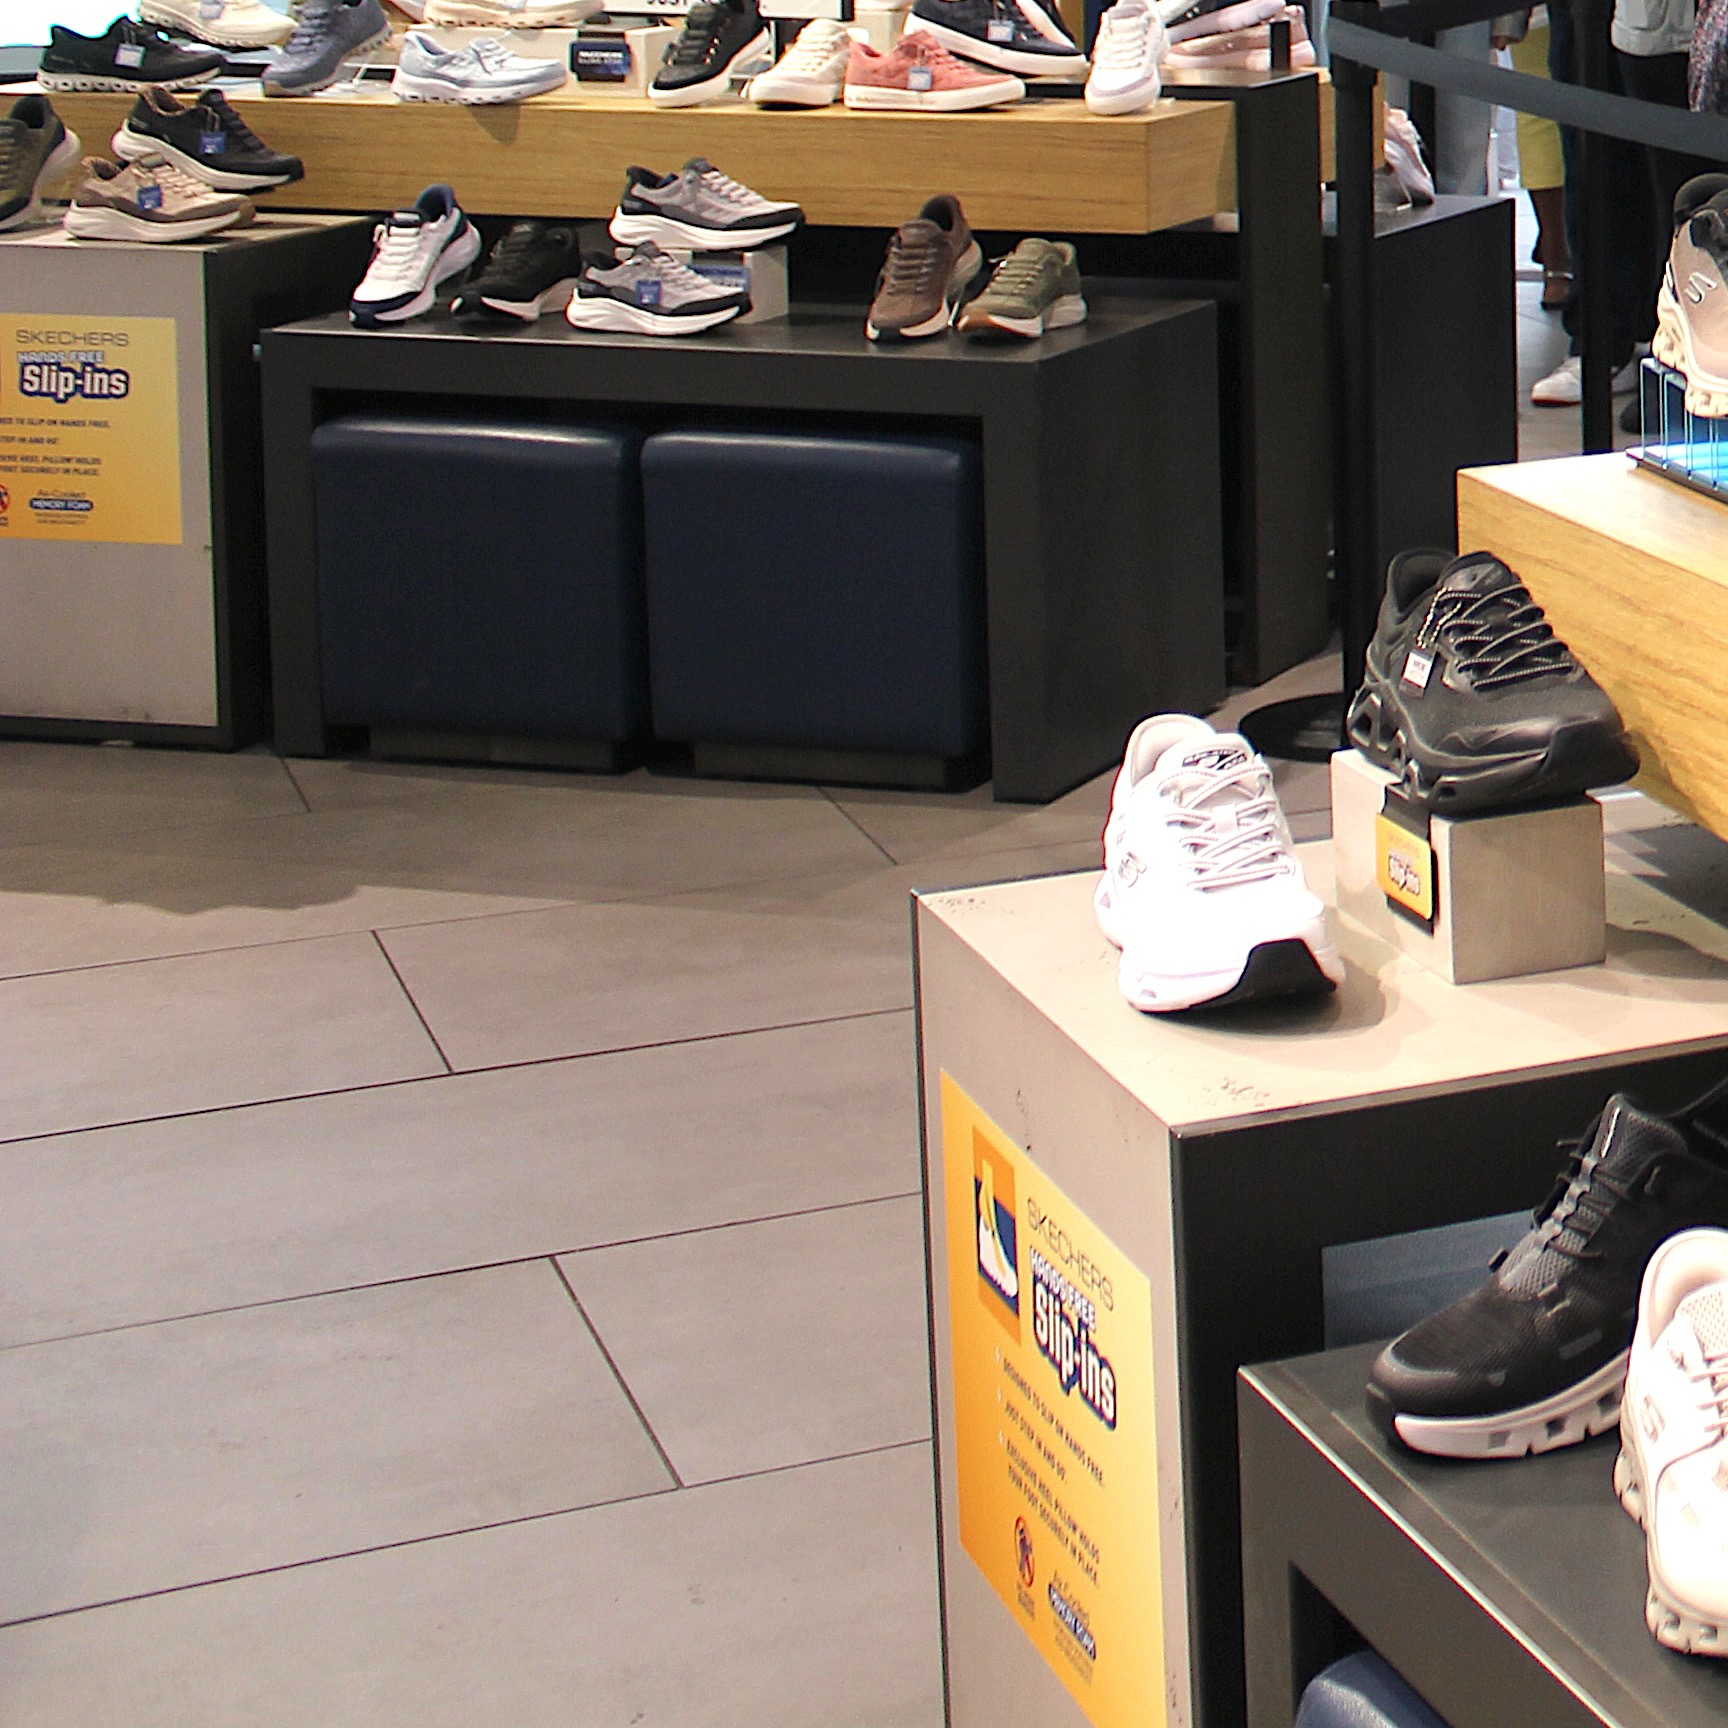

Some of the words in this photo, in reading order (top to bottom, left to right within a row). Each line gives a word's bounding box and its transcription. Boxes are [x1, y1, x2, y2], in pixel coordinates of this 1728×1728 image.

[16, 329, 129, 347] SKECHERS
[21, 363, 130, 401] Slip-ins
[1027, 1197, 1114, 1312] SKECHERS
[1034, 1278, 1116, 1428] Slip-ins
